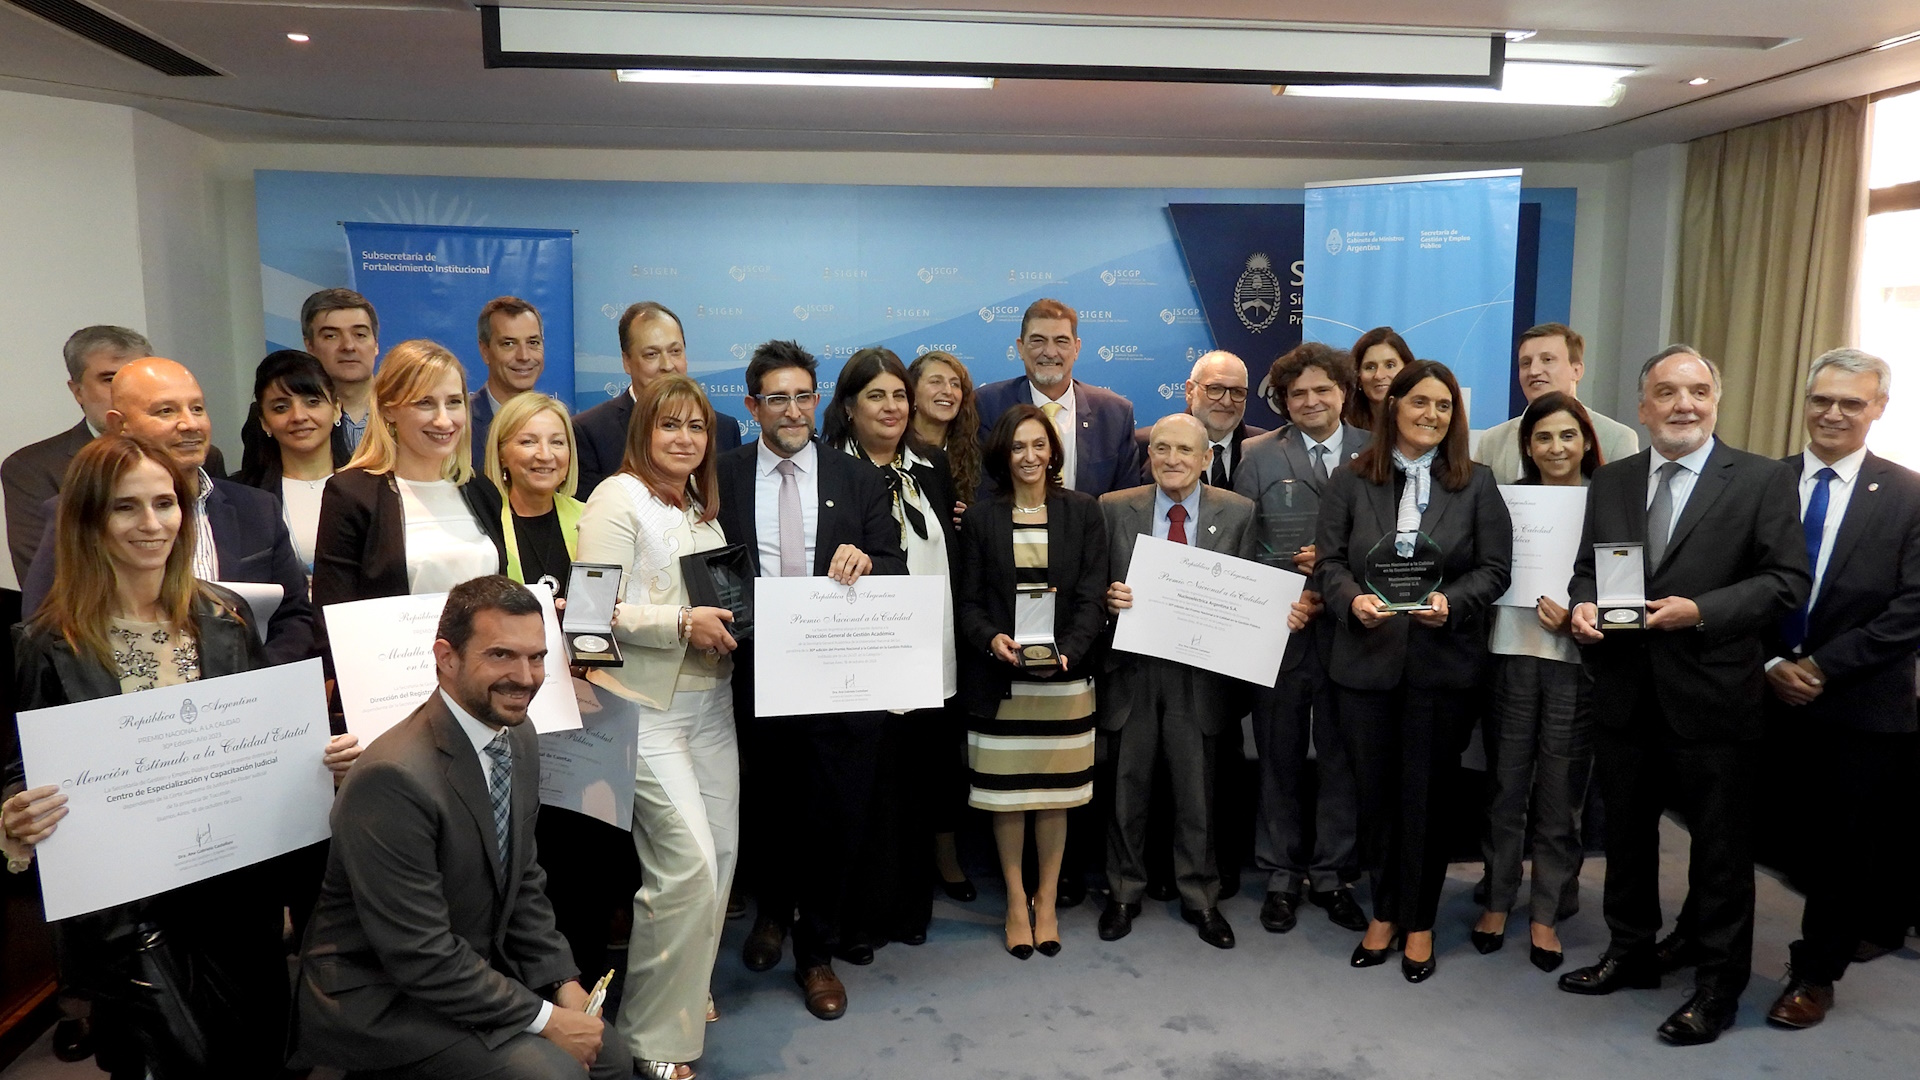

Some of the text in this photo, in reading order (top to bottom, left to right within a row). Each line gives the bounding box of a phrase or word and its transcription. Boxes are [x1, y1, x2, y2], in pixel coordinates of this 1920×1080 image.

[1346, 244, 1380, 253] Argentina
[362, 250, 437, 262] Subsecretaría de
[362, 262, 490, 275] Fortalecimiento Institucional
[643, 267, 678, 276] SIGEN
[834, 269, 868, 278] SIGEN
[930, 267, 959, 275] ISCGP
[1113, 269, 1141, 277] ISCGP
[1019, 271, 1052, 280] SIGEN
[708, 307, 743, 315] SIGEN
[806, 304, 834, 312] ISCGP
[896, 309, 930, 317] SIGEN
[992, 306, 1020, 314] ISCGP
[1173, 308, 1200, 316] ISCGP
[1079, 310, 1112, 319] SIGEN
[1111, 345, 1138, 353] ISCGP
[710, 385, 744, 393] SIGEN
[1179, 557, 1257, 583] República Argentina
[1158, 571, 1185, 585] Premio
[1186, 580, 1225, 594] Nacional
[1229, 590, 1237, 599] la
[1238, 590, 1269, 606] Calidad
[809, 590, 896, 602] República Argentina
[398, 611, 439, 625] República
[790, 613, 822, 625] Premio
[823, 612, 866, 624] Nacional
[871, 613, 880, 622] la
[880, 610, 914, 622] Calidad
[377, 646, 425, 662] Medalla
[369, 693, 399, 704] Dirección
[399, 691, 409, 699] del
[119, 696, 258, 730] República Argentina
[137, 732, 165, 744] PREMIO
[164, 726, 199, 740] NACIONAL
[205, 723, 214, 731] LA
[214, 717, 241, 729] CALIDAD
[585, 726, 615, 744] Calidad
[61, 722, 310, 789] Mención Estímulo a la Calidad Estatal
[106, 756, 279, 804] Centro de Especialización y Capacitación Judicial
